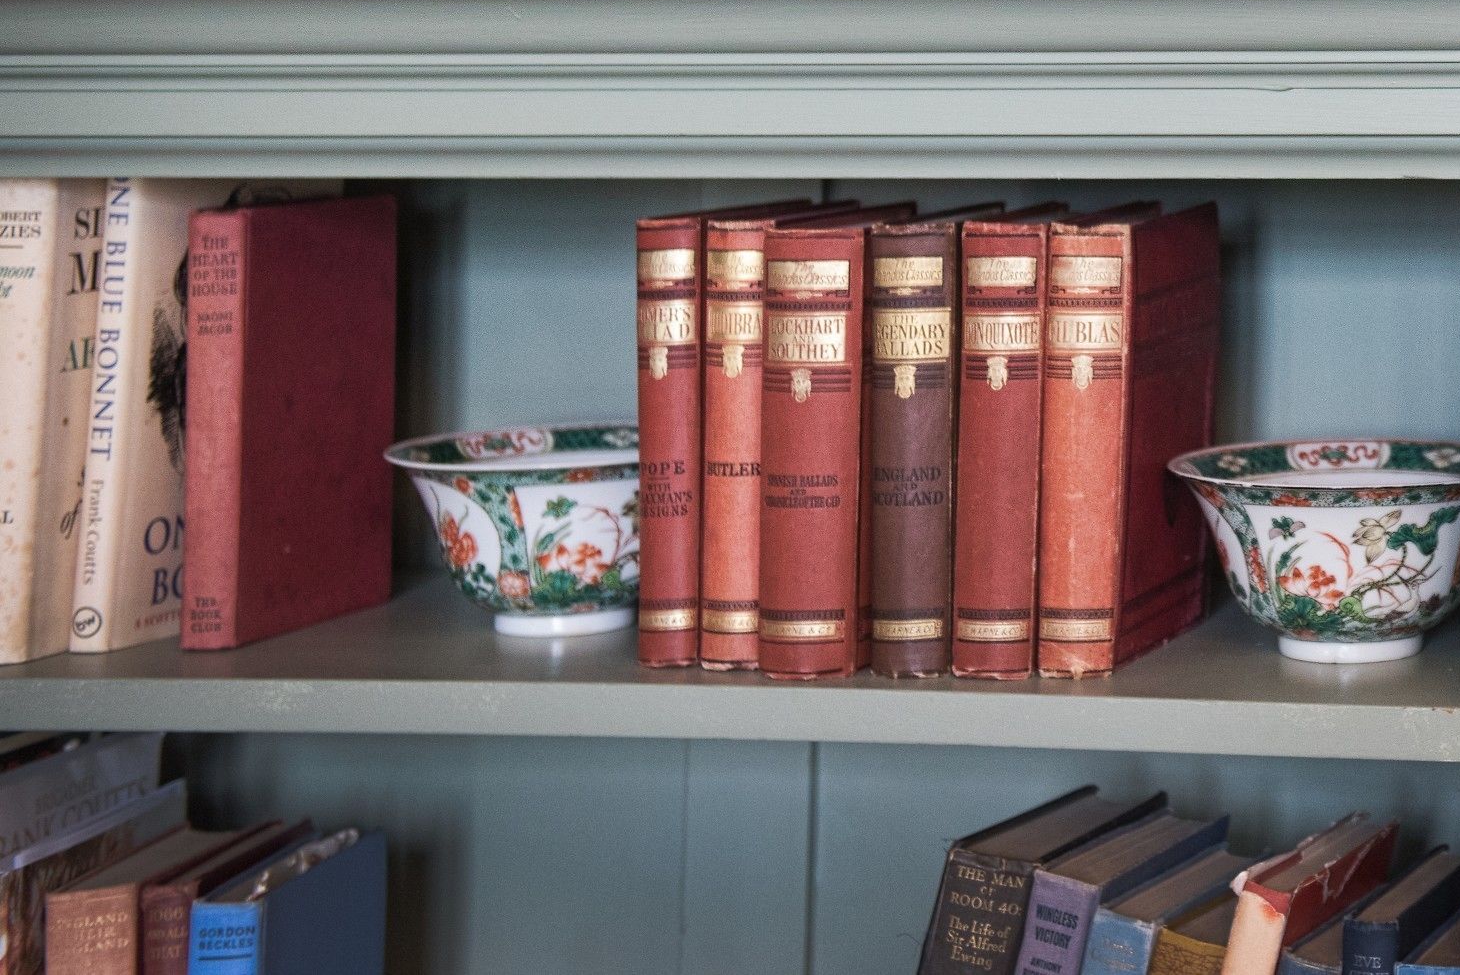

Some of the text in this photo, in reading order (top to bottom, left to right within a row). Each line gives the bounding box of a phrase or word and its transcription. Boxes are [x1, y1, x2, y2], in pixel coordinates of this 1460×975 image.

[202, 235, 229, 250] THE
[91, 178, 131, 461] NE BLUE BONNET
[771, 318, 843, 334] LOCKHART
[892, 315, 918, 324] THE
[793, 335, 815, 344] AND
[876, 323, 948, 340] EGENDARY
[1076, 321, 1120, 344] BLAS
[771, 343, 841, 360] SOUTHEY
[707, 461, 761, 476] BUTLER
[873, 467, 941, 482] ENGLAND
[83, 530, 101, 585] Coutts
[958, 865, 1026, 888] THE MAN
[951, 892, 994, 912] ROOM
[1036, 903, 1079, 930] WINGLESS
[200, 927, 256, 938] GORDON
[949, 915, 1012, 938] The Life of
[199, 939, 255, 950] BECKLES
[946, 929, 1007, 953] Sir Alfred
[1034, 926, 1072, 950] VICTORY
[950, 945, 993, 970] Ewing
[1353, 954, 1382, 969] EVE
